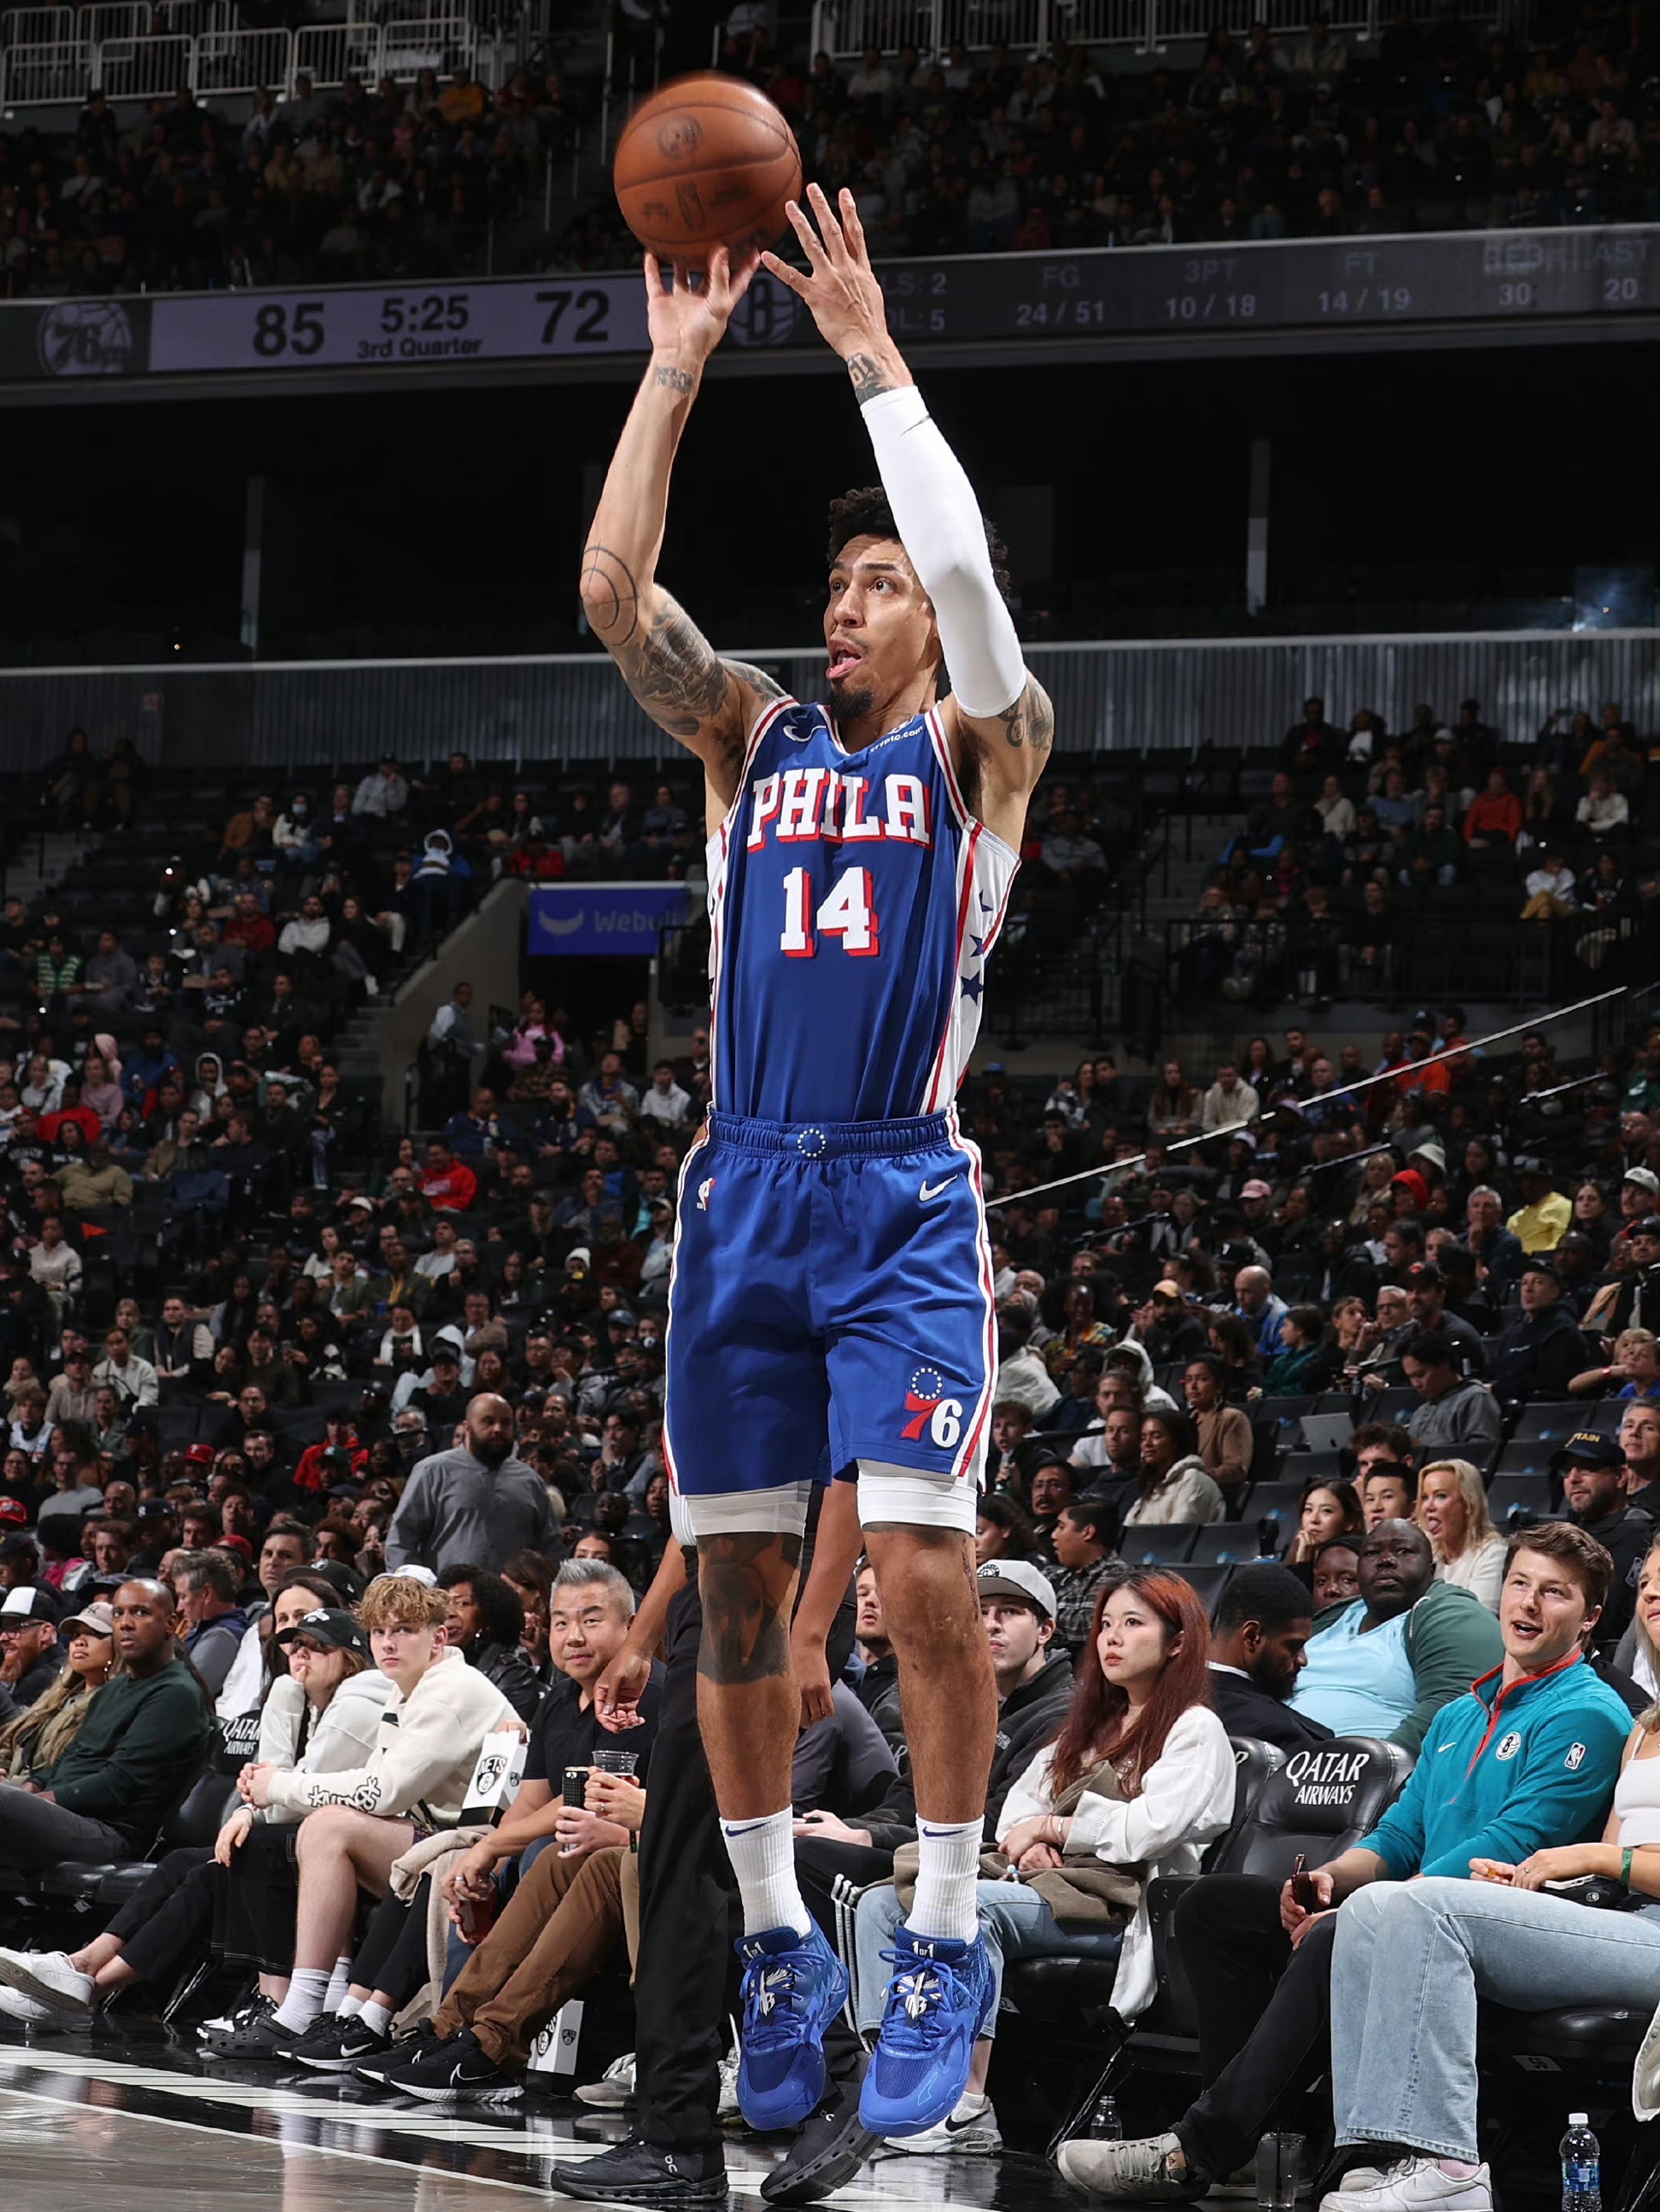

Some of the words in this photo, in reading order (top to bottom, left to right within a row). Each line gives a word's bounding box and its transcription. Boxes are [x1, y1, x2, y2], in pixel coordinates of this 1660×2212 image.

[1185, 259, 1236, 283] 3PT
[1345, 252, 1381, 274] FT
[931, 272, 947, 295] 2
[1043, 266, 1080, 289] FG
[1604, 277, 1639, 302] 20
[1166, 296, 1196, 318] 10
[1226, 294, 1257, 317] 18
[1316, 291, 1348, 313] 14
[1381, 287, 1411, 310] 19
[1500, 283, 1533, 306] 30
[381, 295, 469, 333] 5:25
[535, 289, 610, 344] 72
[930, 309, 946, 331] 5
[1016, 302, 1048, 327] 24
[1076, 301, 1105, 324] 51
[254, 302, 324, 357] 85
[357, 338, 393, 359] 3rd
[400, 335, 482, 357] Quarter
[869, 725, 924, 753] crypto.com
[746, 767, 933, 852] PHILA
[780, 866, 880, 957] 14
[899, 1391, 963, 1449] 76
[478, 1758, 507, 1775] NETS
[1285, 1750, 1370, 1788] QATAR
[1294, 1784, 1356, 1806] AIRWAYS
[912, 1941, 920, 1956] 1
[927, 1943, 935, 1958] 1
